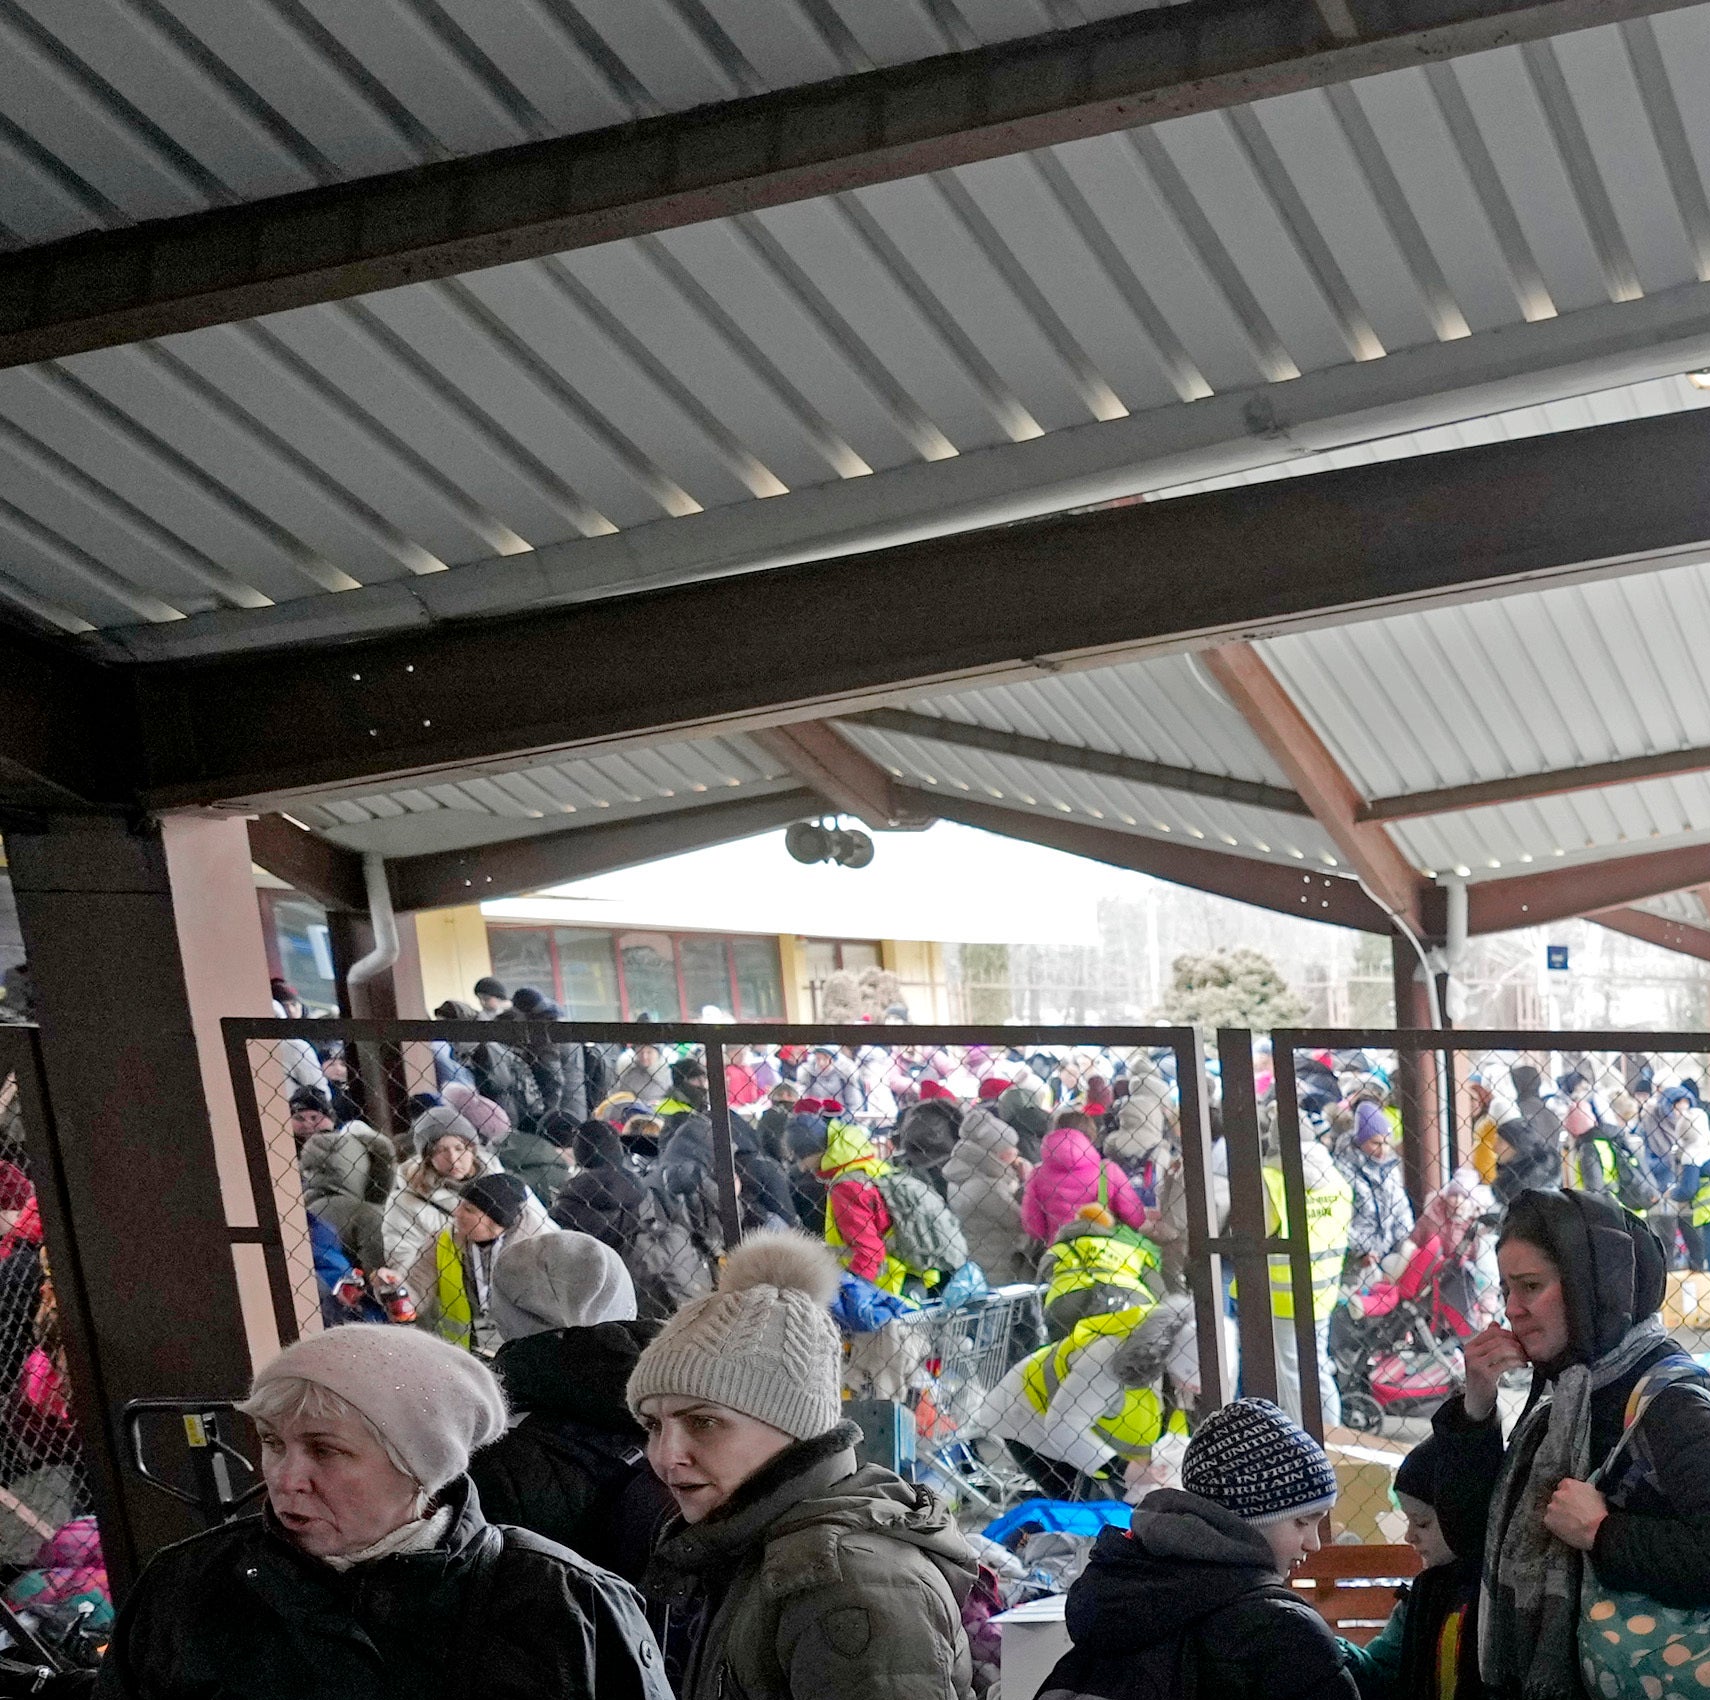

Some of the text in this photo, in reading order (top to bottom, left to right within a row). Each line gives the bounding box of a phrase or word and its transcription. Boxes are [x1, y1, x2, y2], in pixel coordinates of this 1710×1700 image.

[1207, 1420, 1271, 1454] BRITAIN
[1220, 1431, 1280, 1461] UNITED
[1218, 1437, 1299, 1474] KINGDOM
[1261, 1457, 1304, 1481] FREE
[1222, 1470, 1305, 1497] BRITAIN
[1236, 1479, 1310, 1506] UNITED
